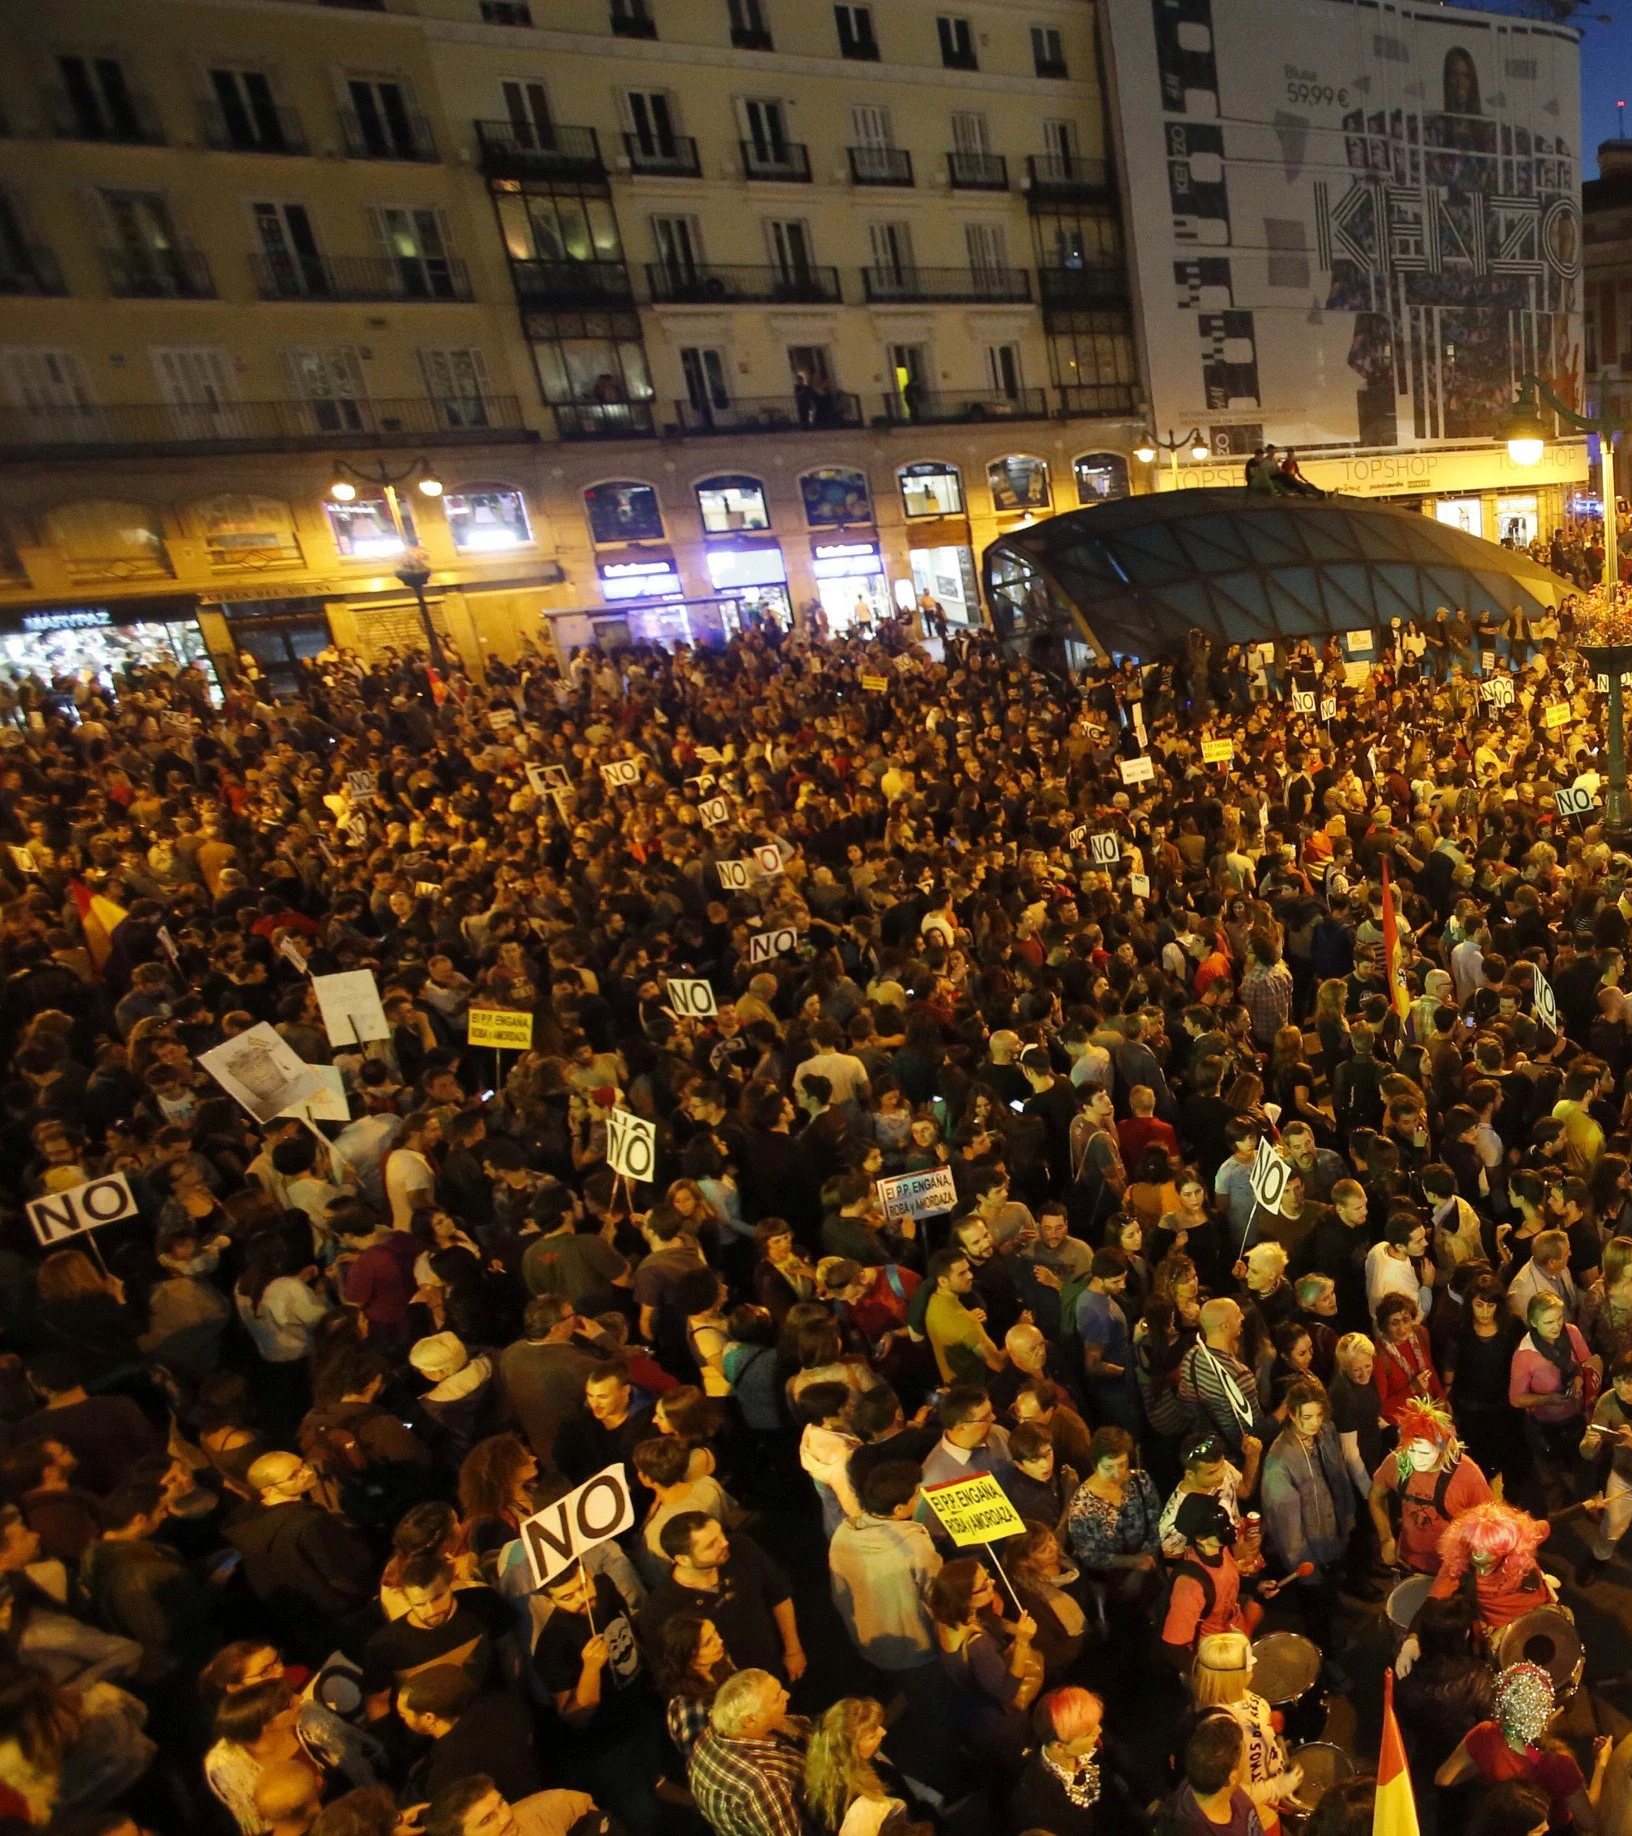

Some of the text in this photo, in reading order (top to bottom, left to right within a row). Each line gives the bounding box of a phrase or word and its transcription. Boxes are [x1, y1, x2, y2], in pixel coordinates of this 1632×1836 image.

[1287, 83, 1333, 105] 59,99
[1313, 182, 1583, 279] KENZO
[1341, 456, 1438, 480] TOPSHOP
[1293, 693, 1313, 710] NO
[1322, 701, 1335, 717] NO
[1495, 690, 1512, 706] NO
[604, 763, 636, 783] NO
[702, 801, 725, 821] NO
[1557, 790, 1589, 813] NO
[1071, 828, 1086, 844] NO
[1093, 836, 1116, 860] NO
[720, 863, 746, 887] NO
[753, 931, 795, 957] NO
[672, 981, 713, 1013] NO
[1535, 968, 1557, 1022] NO
[609, 1121, 650, 1176] NO
[887, 1190, 895, 1201] El
[913, 1174, 951, 1194] ENGAÑA,
[1251, 1148, 1288, 1206] NO
[32, 1180, 129, 1240] NO
[931, 1496, 942, 1512] El
[958, 1482, 1003, 1507] ENGAÑA,
[527, 1475, 626, 1578] NO
[945, 1518, 968, 1535] ROBA
